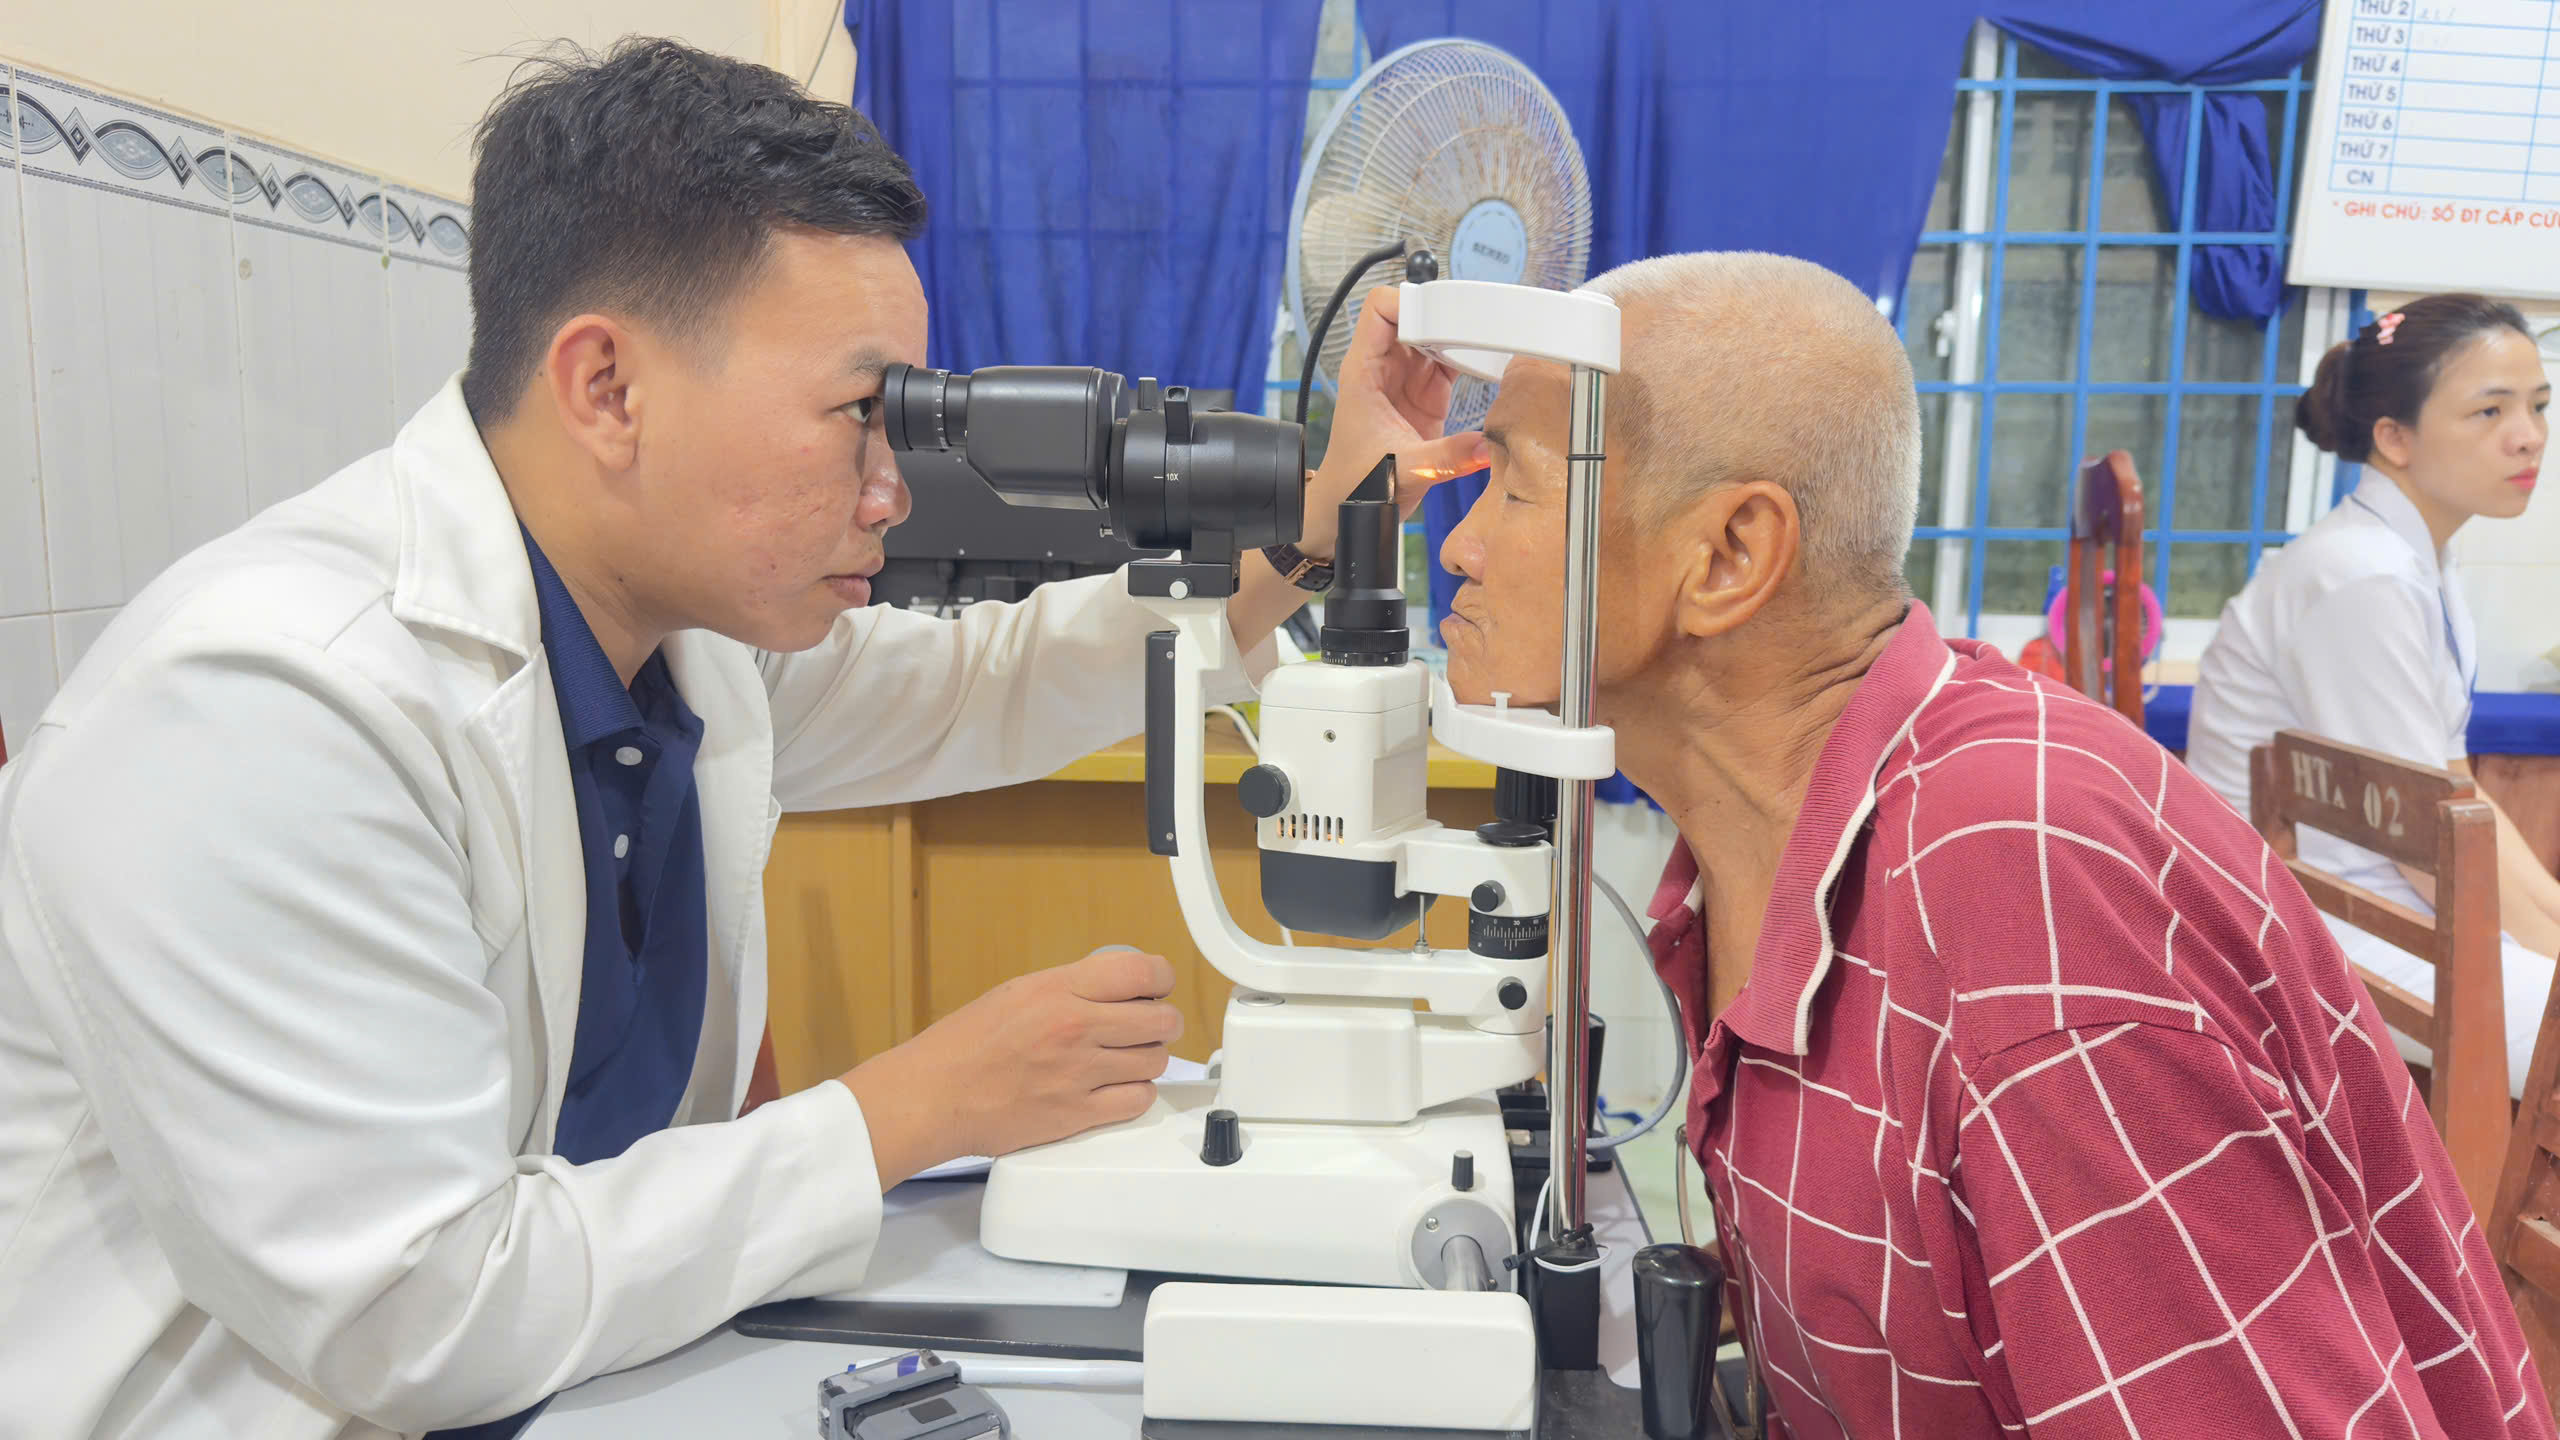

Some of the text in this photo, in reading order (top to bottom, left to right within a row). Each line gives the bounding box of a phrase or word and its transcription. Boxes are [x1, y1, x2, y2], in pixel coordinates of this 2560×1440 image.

[2398, 1, 2409, 16] 2
[2356, 24, 2404, 45] THỨ 3
[2352, 53, 2400, 73] THỨ 4
[2348, 82, 2396, 102] THỨ 5
[2345, 110, 2392, 130] THỨ 6
[2341, 139, 2388, 159] THỨ 7
[2346, 169, 2375, 185] CN
[2344, 201, 2376, 217] GHI
[2432, 202, 2456, 222] SỐ
[1166, 472, 1179, 481] 10X
[2363, 781, 2404, 838] 02
